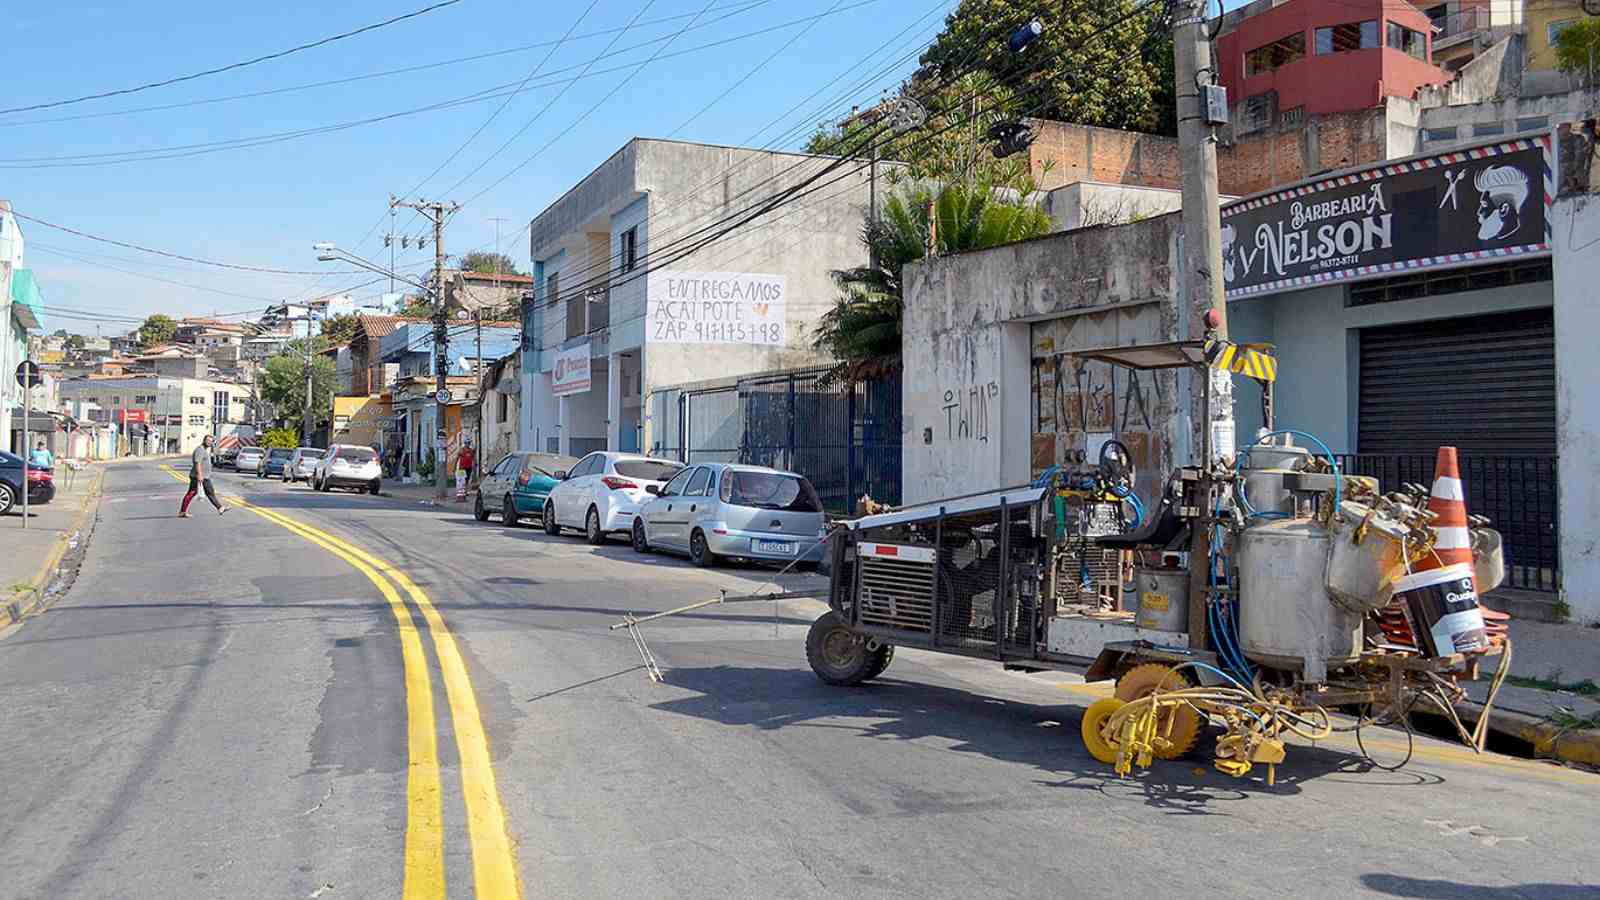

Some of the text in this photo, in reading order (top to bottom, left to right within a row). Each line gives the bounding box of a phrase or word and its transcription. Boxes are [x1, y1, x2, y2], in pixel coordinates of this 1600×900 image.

[1255, 213, 1393, 276] NELSON
[668, 279, 781, 301] ENTREGAMOS
[703, 301, 742, 321] POTE
[654, 321, 688, 340] ZAP
